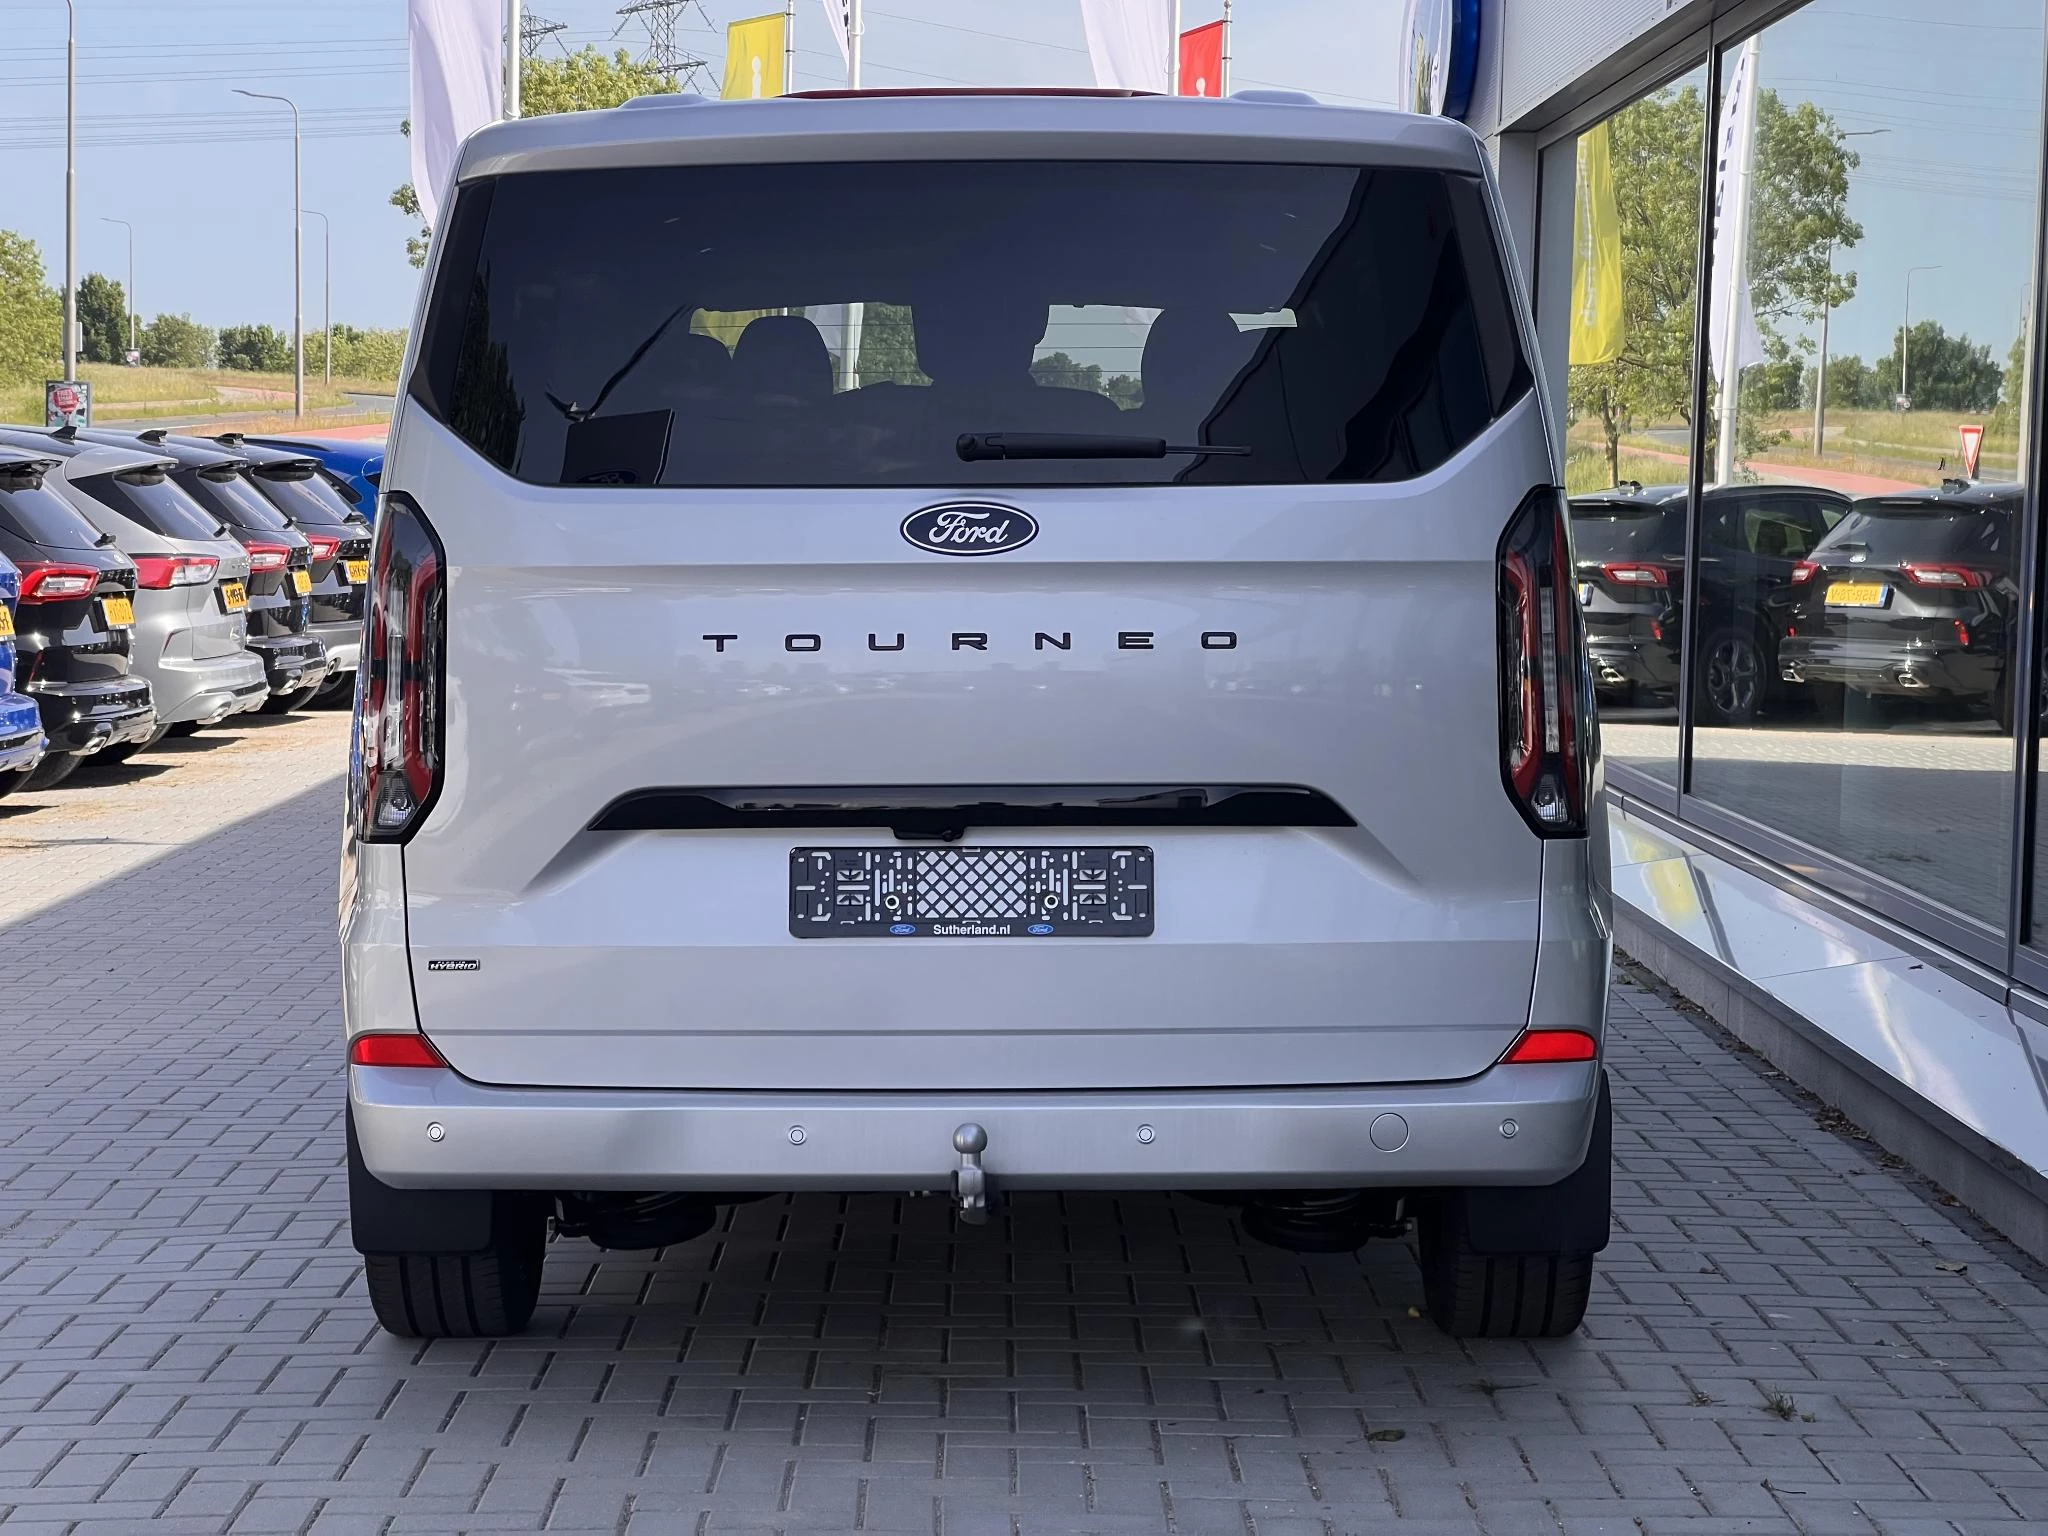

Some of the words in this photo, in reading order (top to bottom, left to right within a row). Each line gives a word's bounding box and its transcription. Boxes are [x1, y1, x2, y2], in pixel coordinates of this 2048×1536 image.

[928, 511, 1010, 543] Ford
[702, 631, 1238, 653] TOURNEO
[933, 924, 1011, 935] Sutherland.nl
